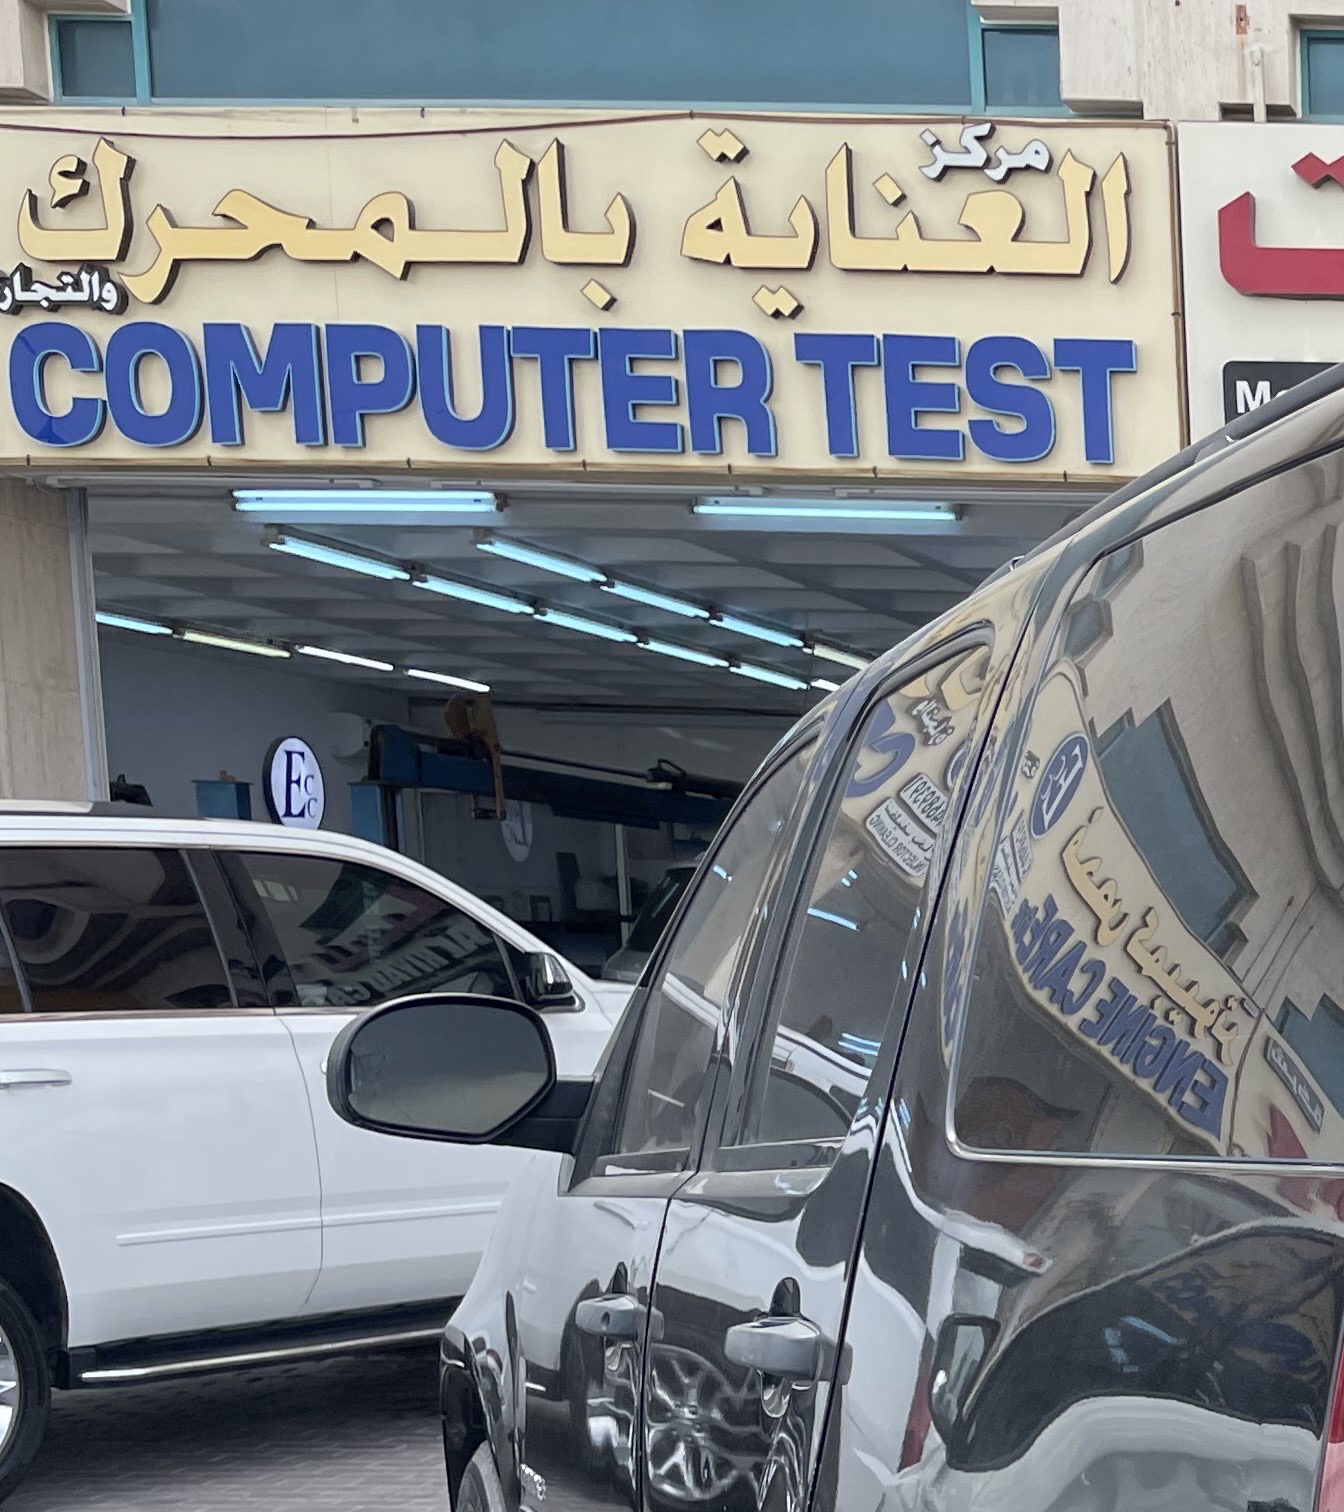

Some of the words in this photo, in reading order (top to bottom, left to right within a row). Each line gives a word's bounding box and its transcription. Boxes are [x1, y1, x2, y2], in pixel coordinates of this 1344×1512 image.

[17, 136, 635, 310] بالمحرك
[680, 127, 1131, 317] العناية
[919, 122, 1053, 183] مركز
[0, 266, 124, 315] والتجار
[8, 321, 778, 456] COMPUTER
[794, 331, 1138, 464] TEST
